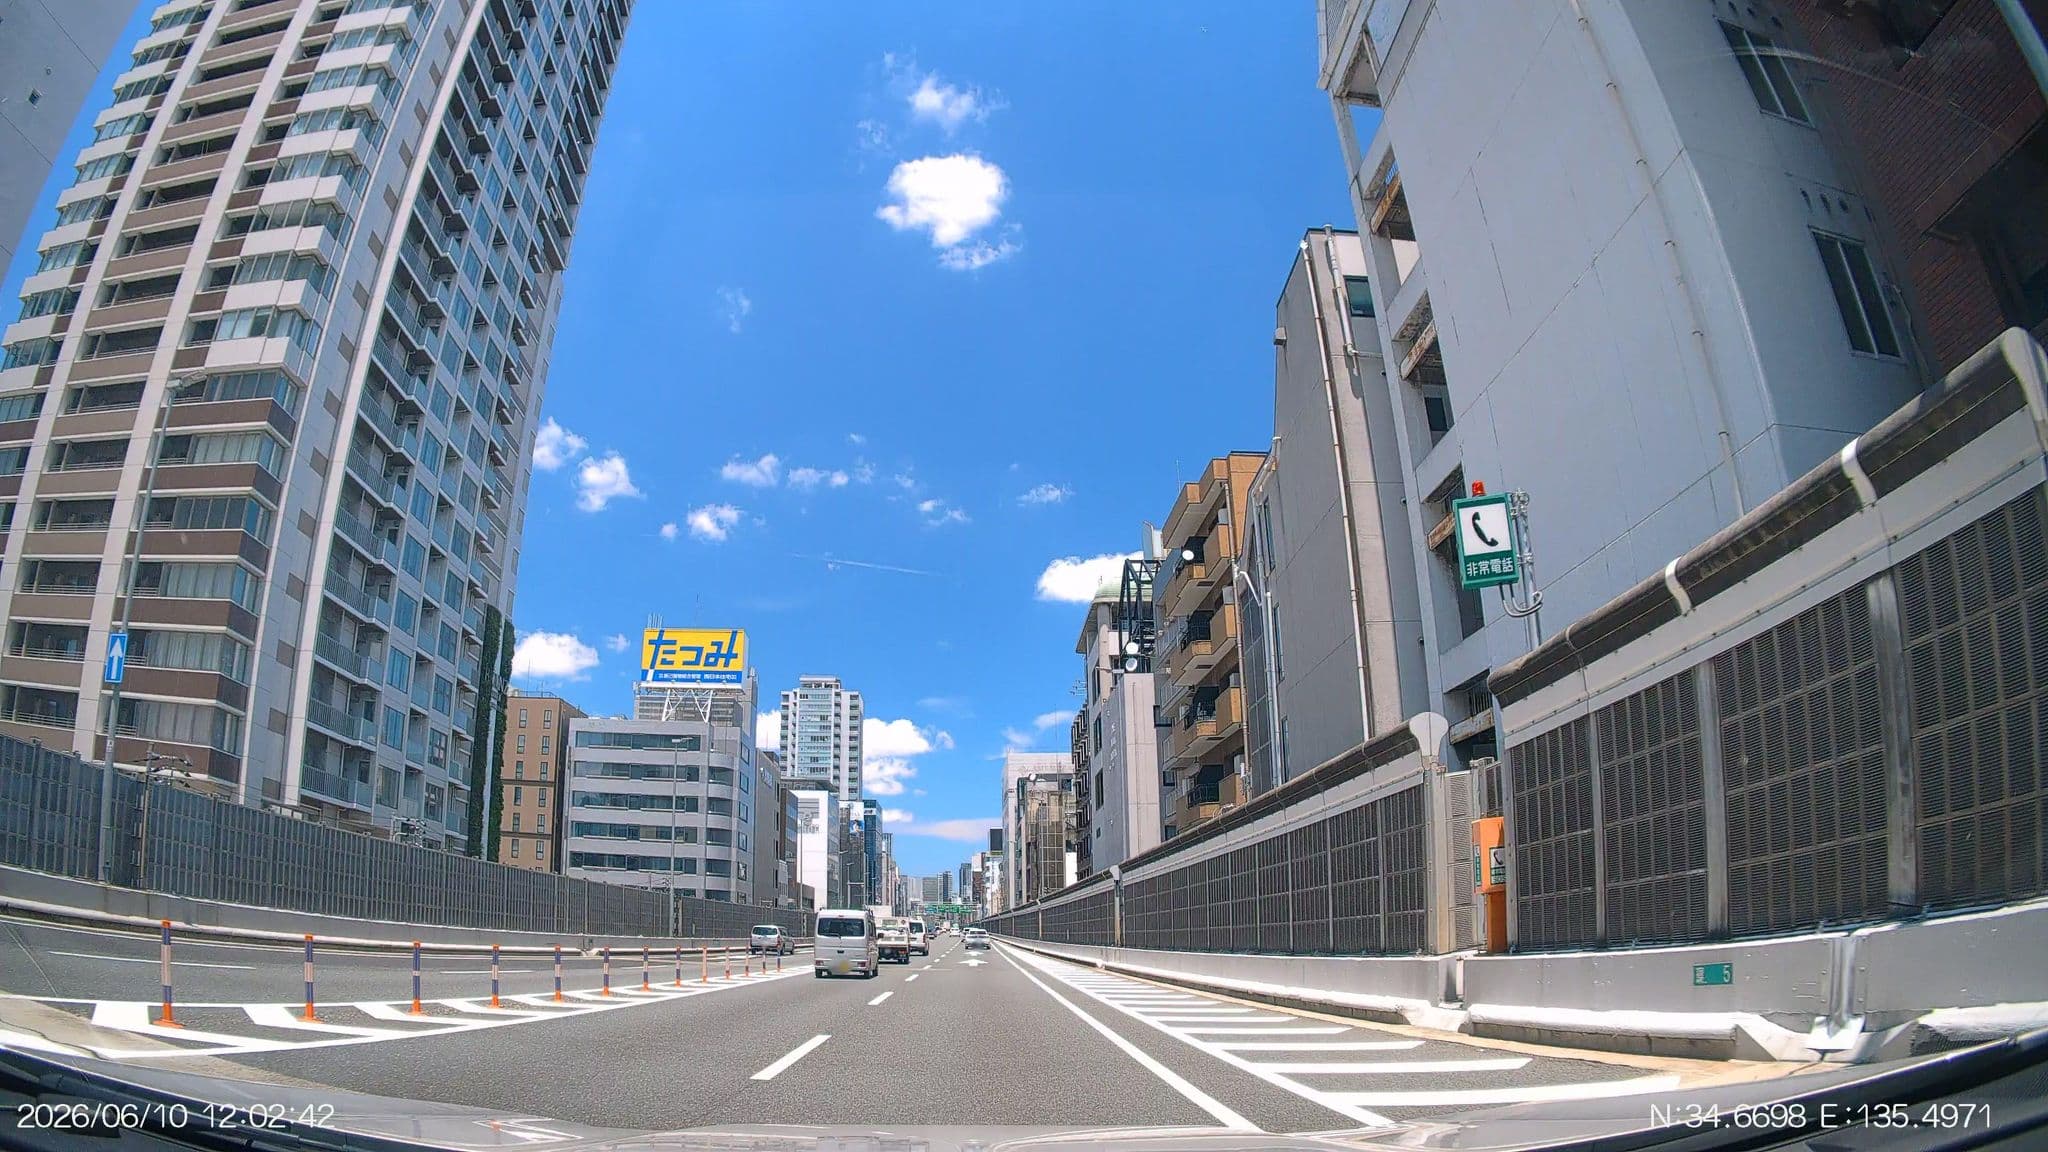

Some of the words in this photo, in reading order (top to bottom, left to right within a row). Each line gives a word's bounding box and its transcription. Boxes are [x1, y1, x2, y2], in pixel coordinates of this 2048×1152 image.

[1466, 557, 1514, 577] 非常電話
[648, 629, 739, 671] たつみ
[1723, 965, 1731, 983] 5
